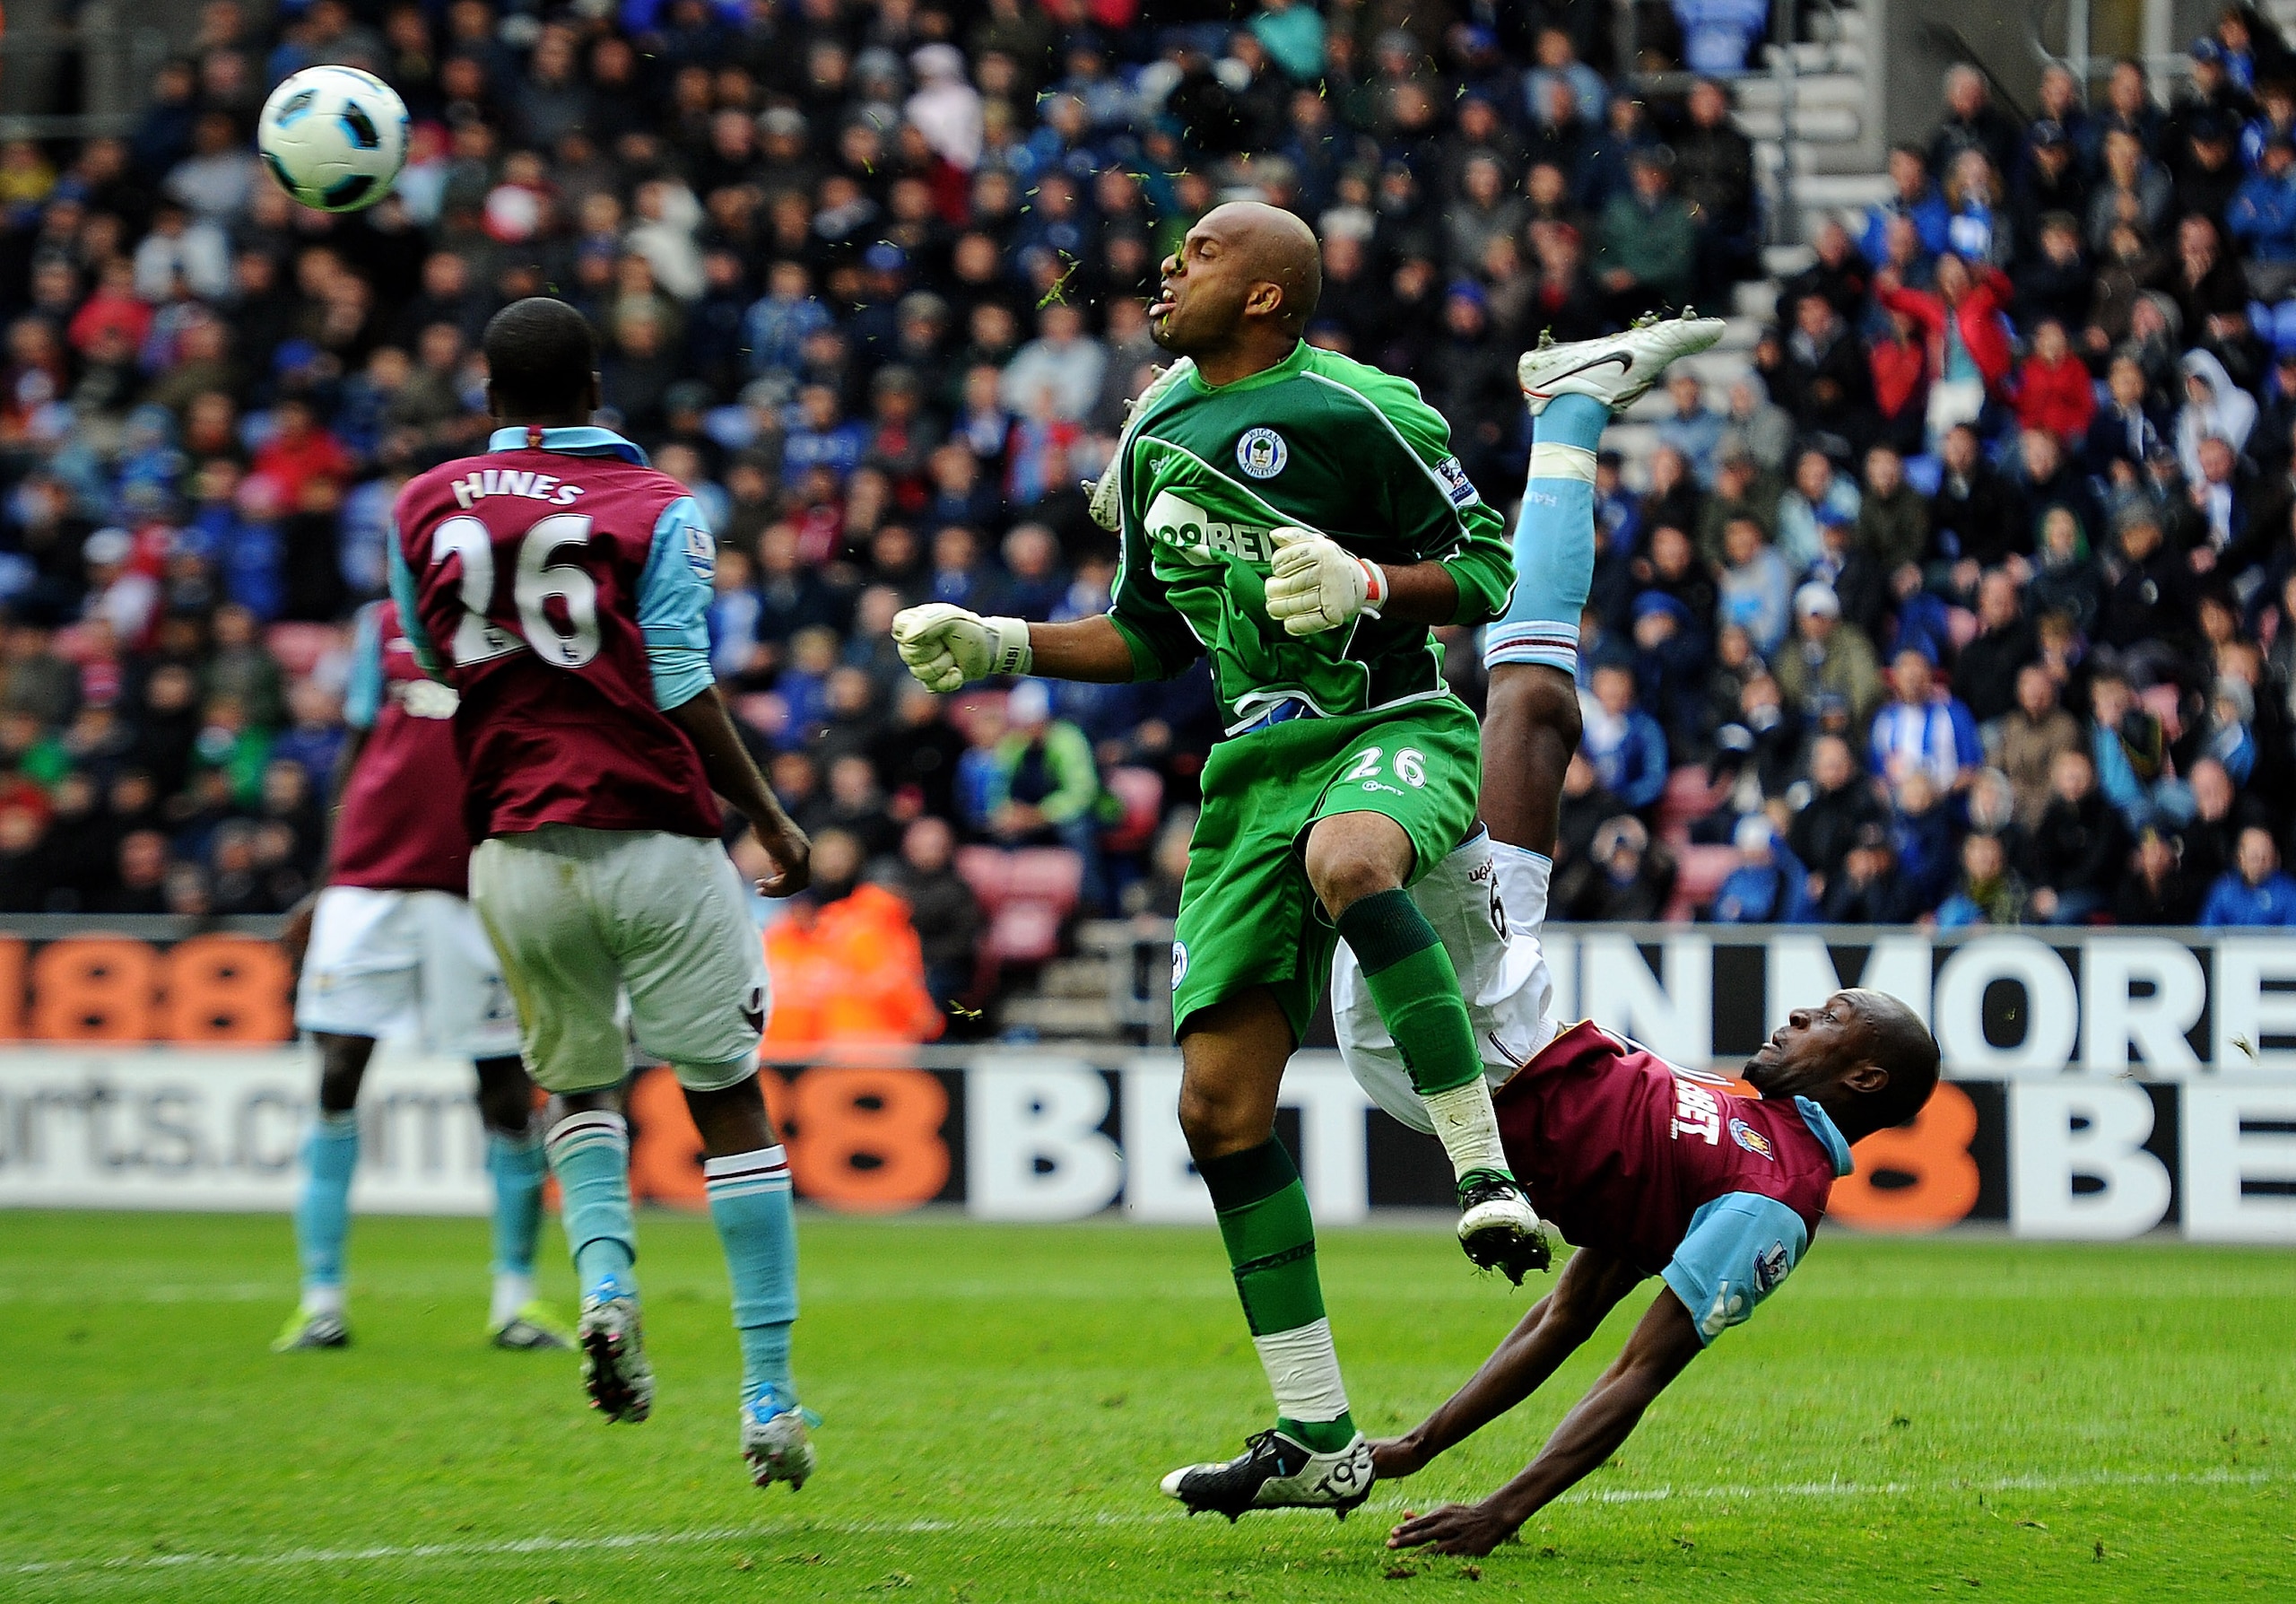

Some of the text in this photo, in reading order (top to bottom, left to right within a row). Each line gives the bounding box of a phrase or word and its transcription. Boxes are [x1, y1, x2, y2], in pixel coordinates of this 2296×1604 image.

[451, 468, 585, 510] HINES
[431, 512, 602, 669] 26
[1344, 745, 1427, 789] 26
[1767, 931, 2296, 1075] MORE
